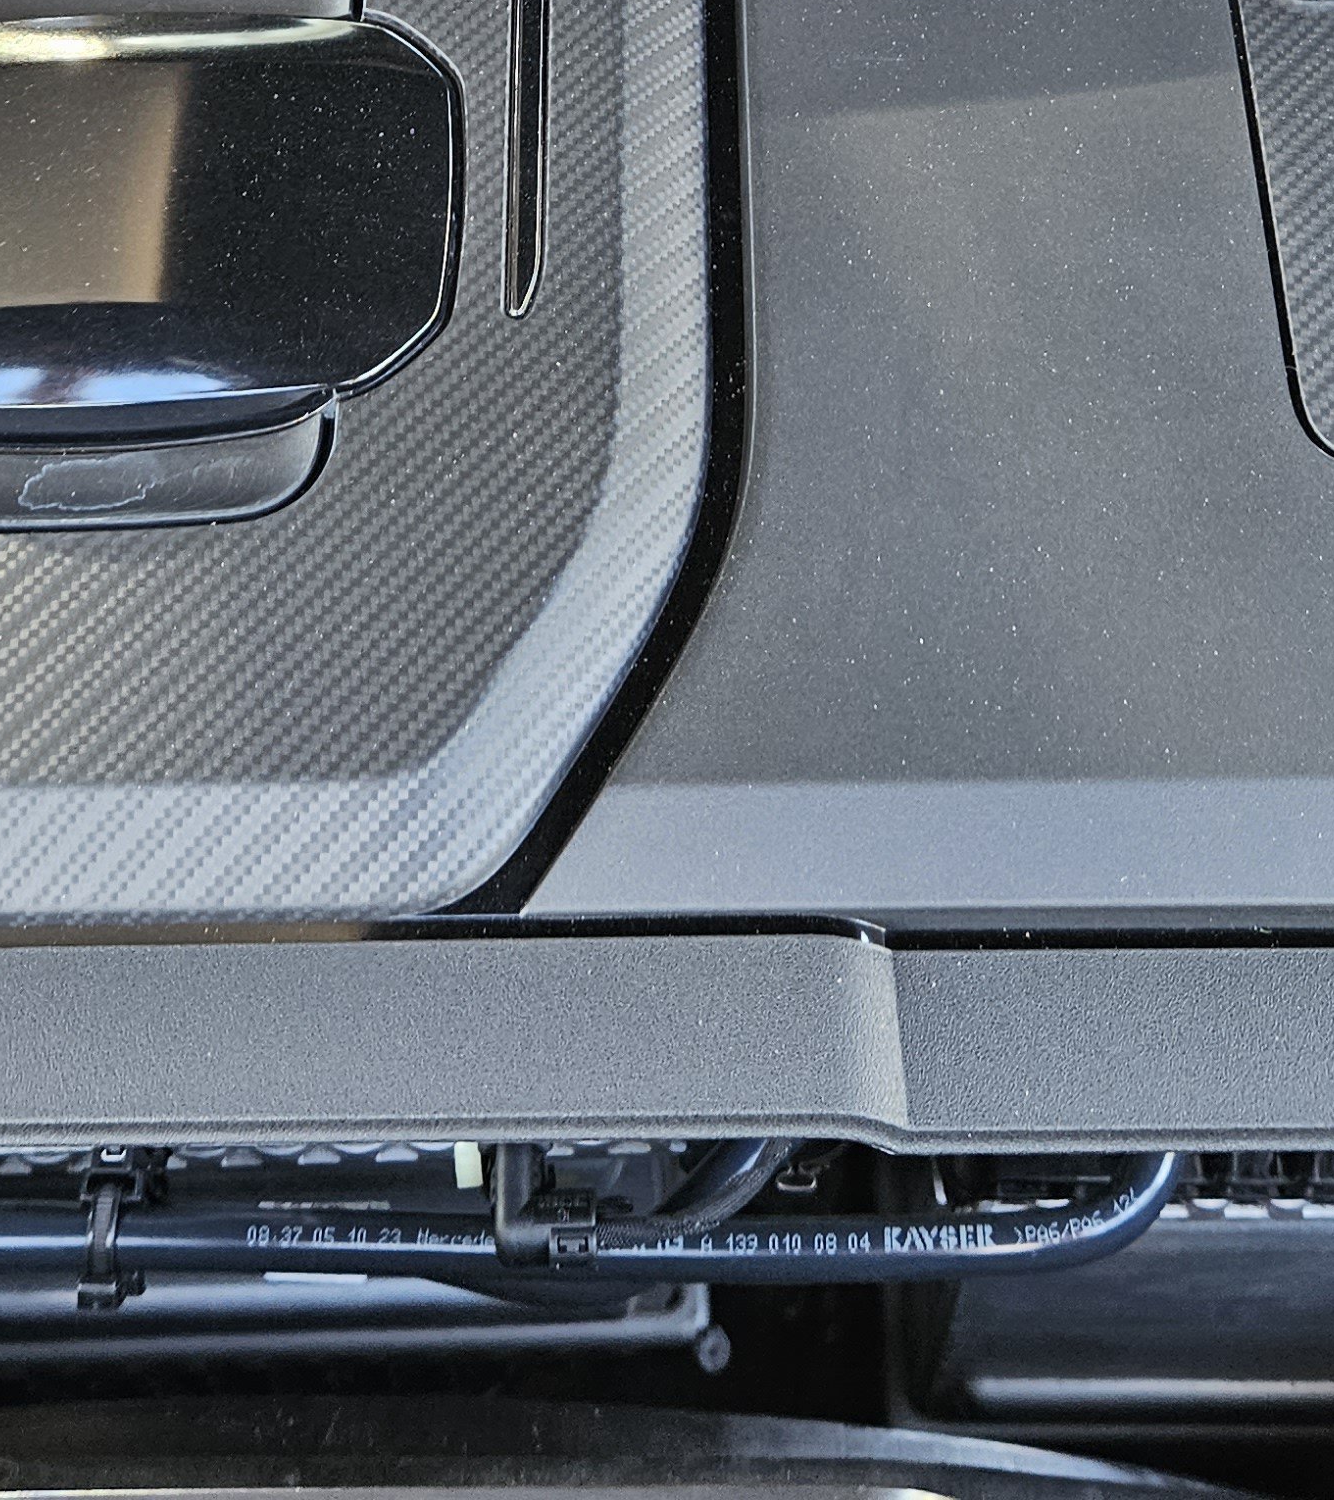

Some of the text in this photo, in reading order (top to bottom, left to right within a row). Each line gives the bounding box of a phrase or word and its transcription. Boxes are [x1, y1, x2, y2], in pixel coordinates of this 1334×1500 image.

[768, 1232, 802, 1256] 010
[848, 1231, 871, 1255] 04
[884, 1223, 997, 1254] KAYSER
